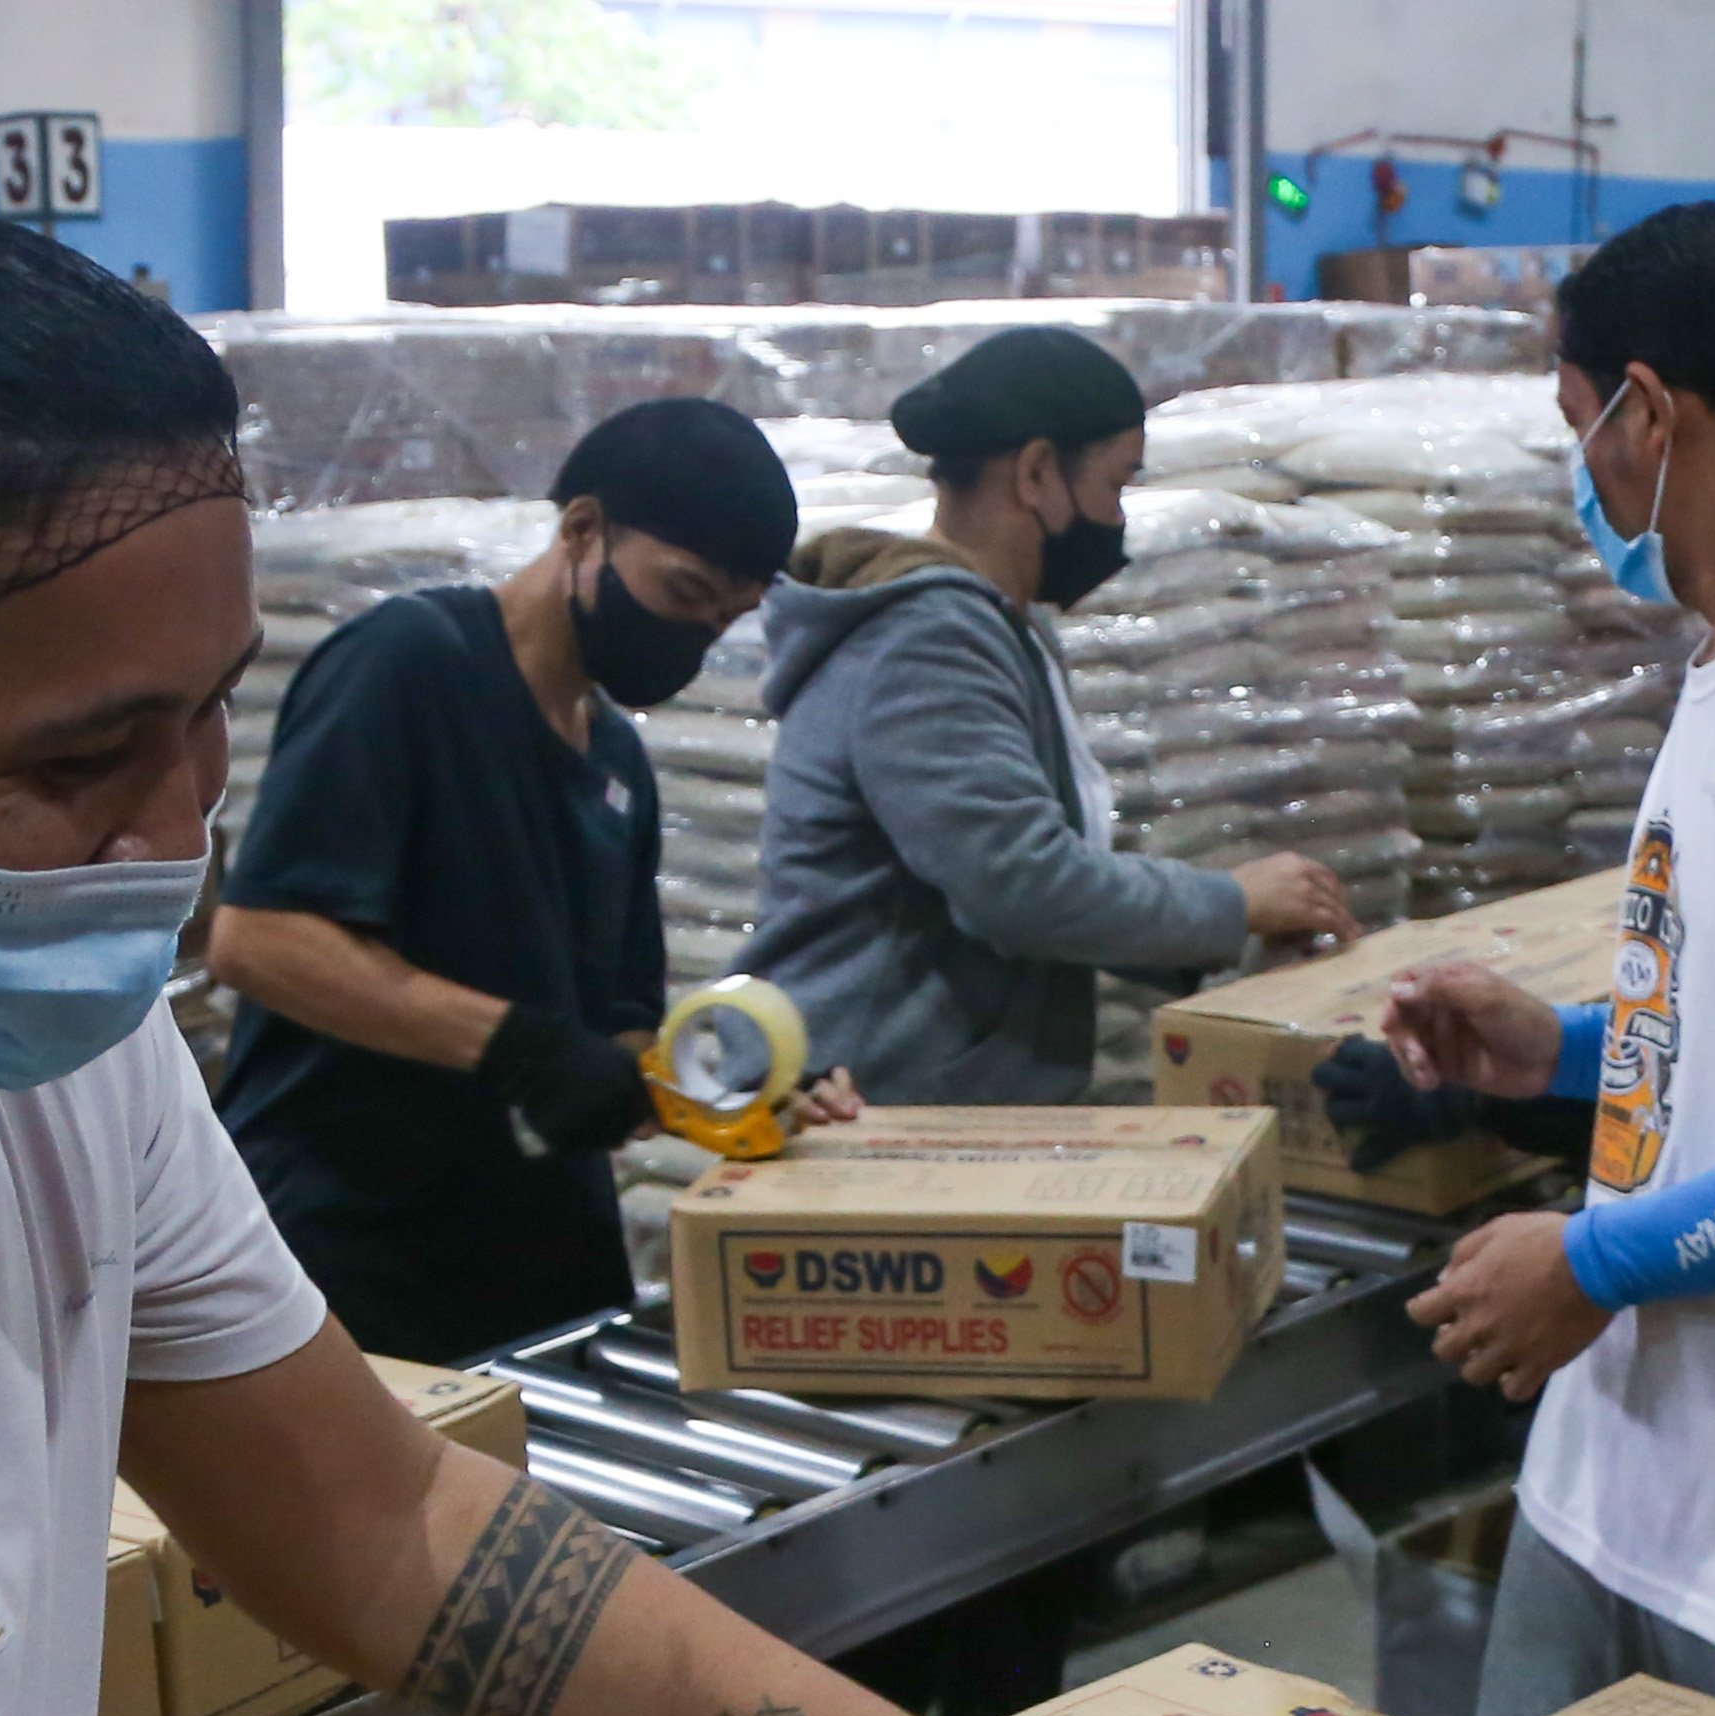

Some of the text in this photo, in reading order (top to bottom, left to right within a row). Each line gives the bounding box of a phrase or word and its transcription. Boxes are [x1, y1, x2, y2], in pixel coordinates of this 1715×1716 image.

[795, 1250, 945, 1294] DSWD
[743, 1314, 1009, 1354] RELIEF SUPPLIES
